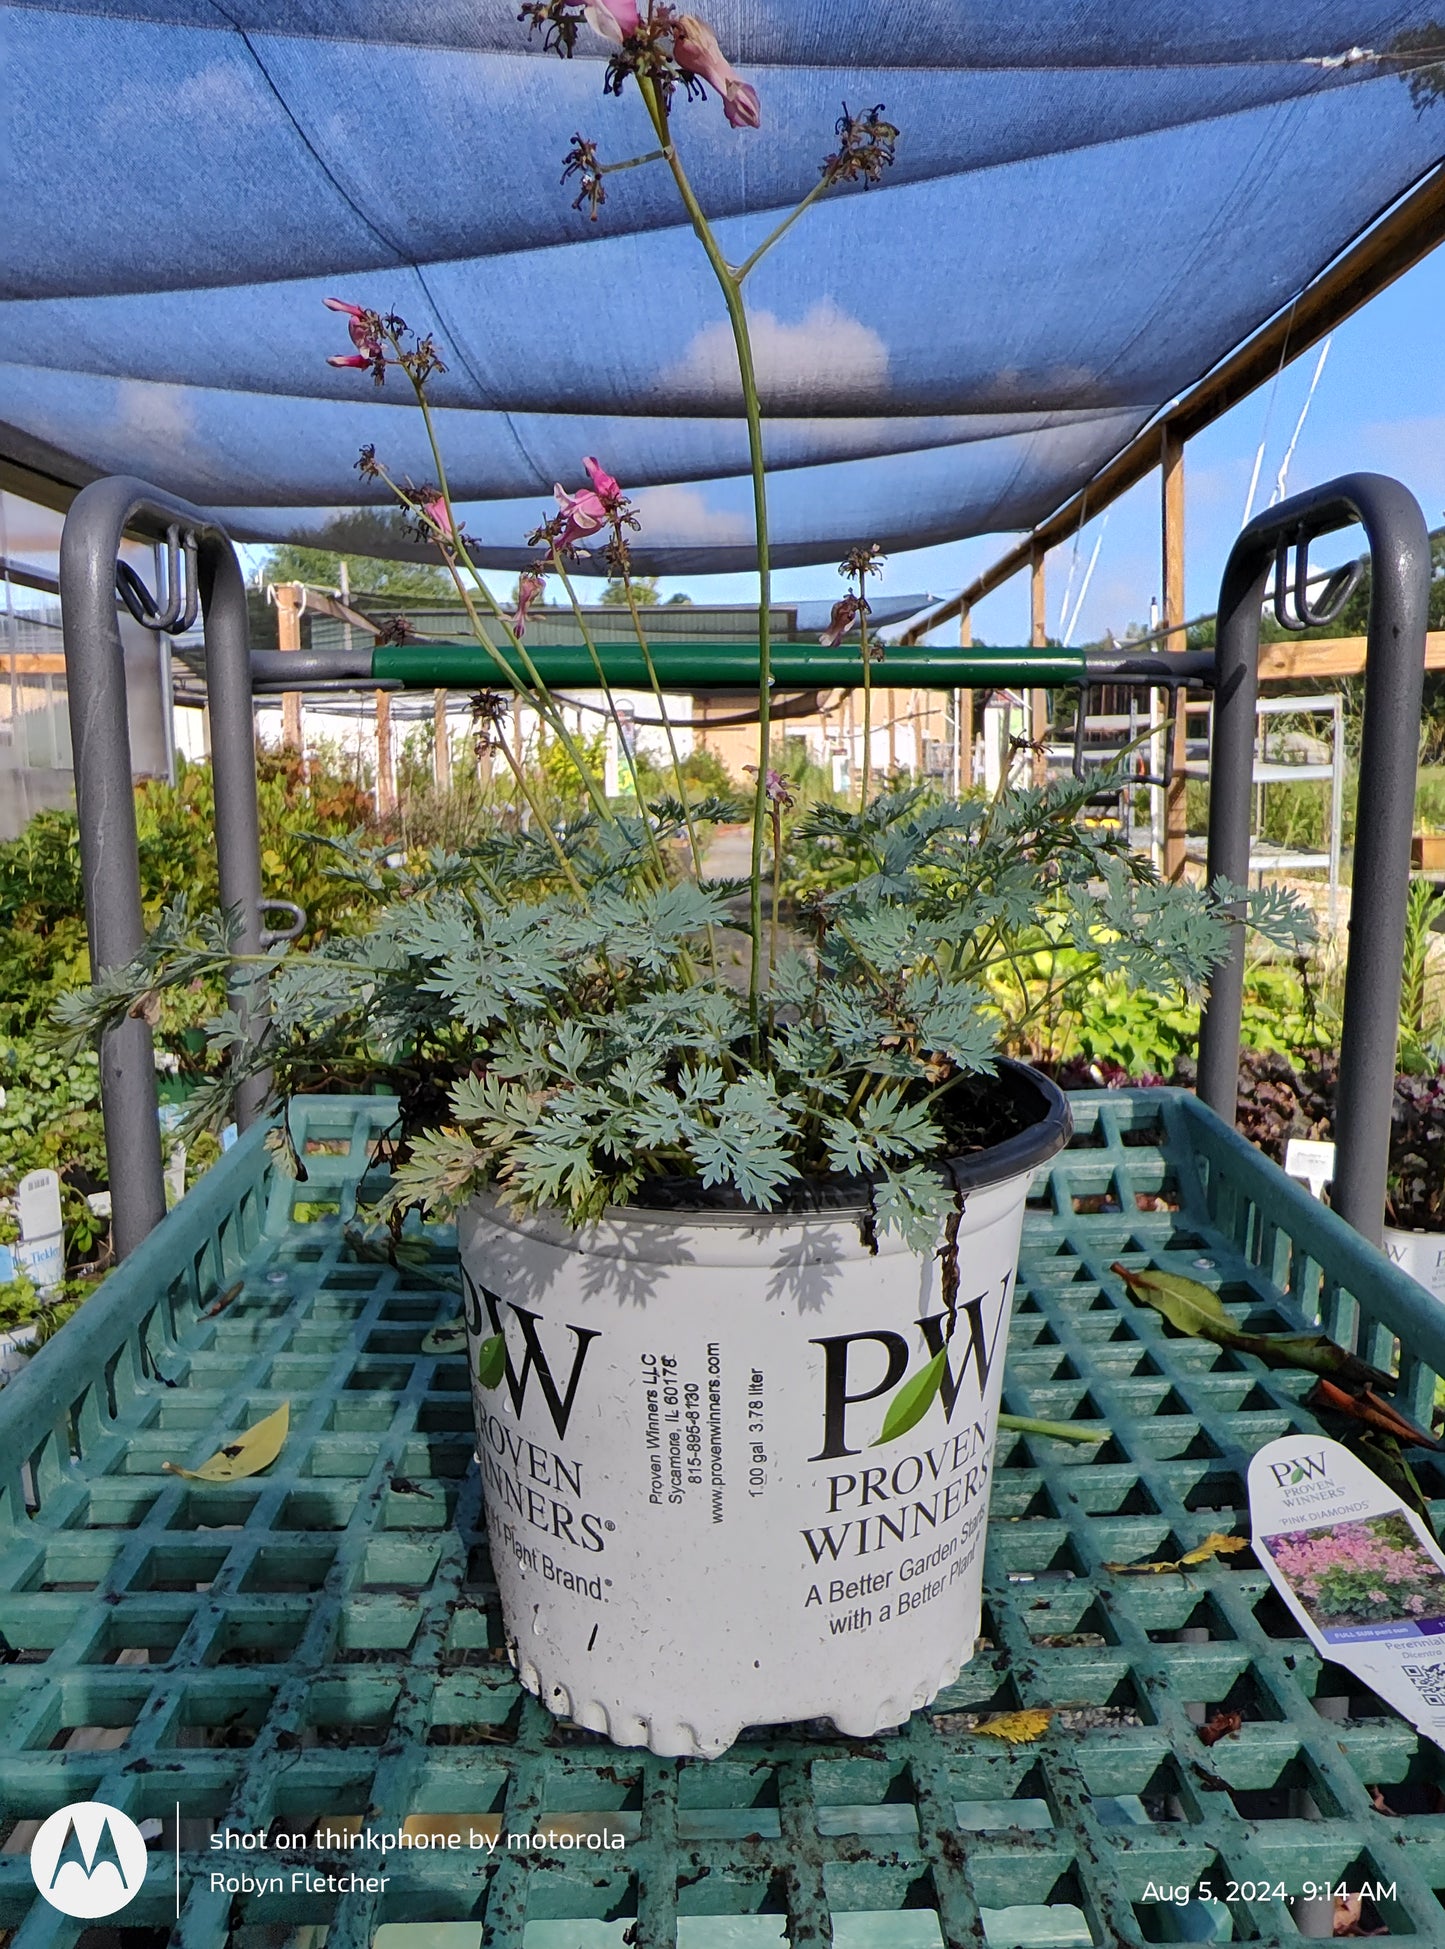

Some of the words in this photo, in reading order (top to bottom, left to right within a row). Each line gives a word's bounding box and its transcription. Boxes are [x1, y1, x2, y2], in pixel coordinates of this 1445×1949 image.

[641, 1353, 658, 1385] LLC
[748, 1368, 763, 1396] liter
[808, 1268, 1012, 1462] PW
[646, 1389, 660, 1449] Winners
[665, 1409, 679, 1422] IL
[707, 1343, 725, 1524] www.provenwinners.com
[749, 1401, 763, 1432] 3.78
[668, 1428, 686, 1504] Sycamore,
[749, 1442, 767, 1463] gal
[826, 1409, 990, 1513] PROVEN
[1267, 1451, 1326, 1489] PW
[649, 1454, 663, 1504] Proven
[749, 1467, 764, 1497] 1.00
[1284, 1479, 1335, 1498] PROVEN
[503, 1523, 538, 1573] Plant
[804, 1584, 822, 1607] A
[829, 1570, 893, 1603] Better
[900, 1537, 957, 1582] Garden
[961, 1503, 985, 1545] Starts
[830, 1607, 872, 1635] with
[879, 1604, 891, 1622] a
[897, 1575, 946, 1616] Better
[1385, 1637, 1445, 1650] Perennial
